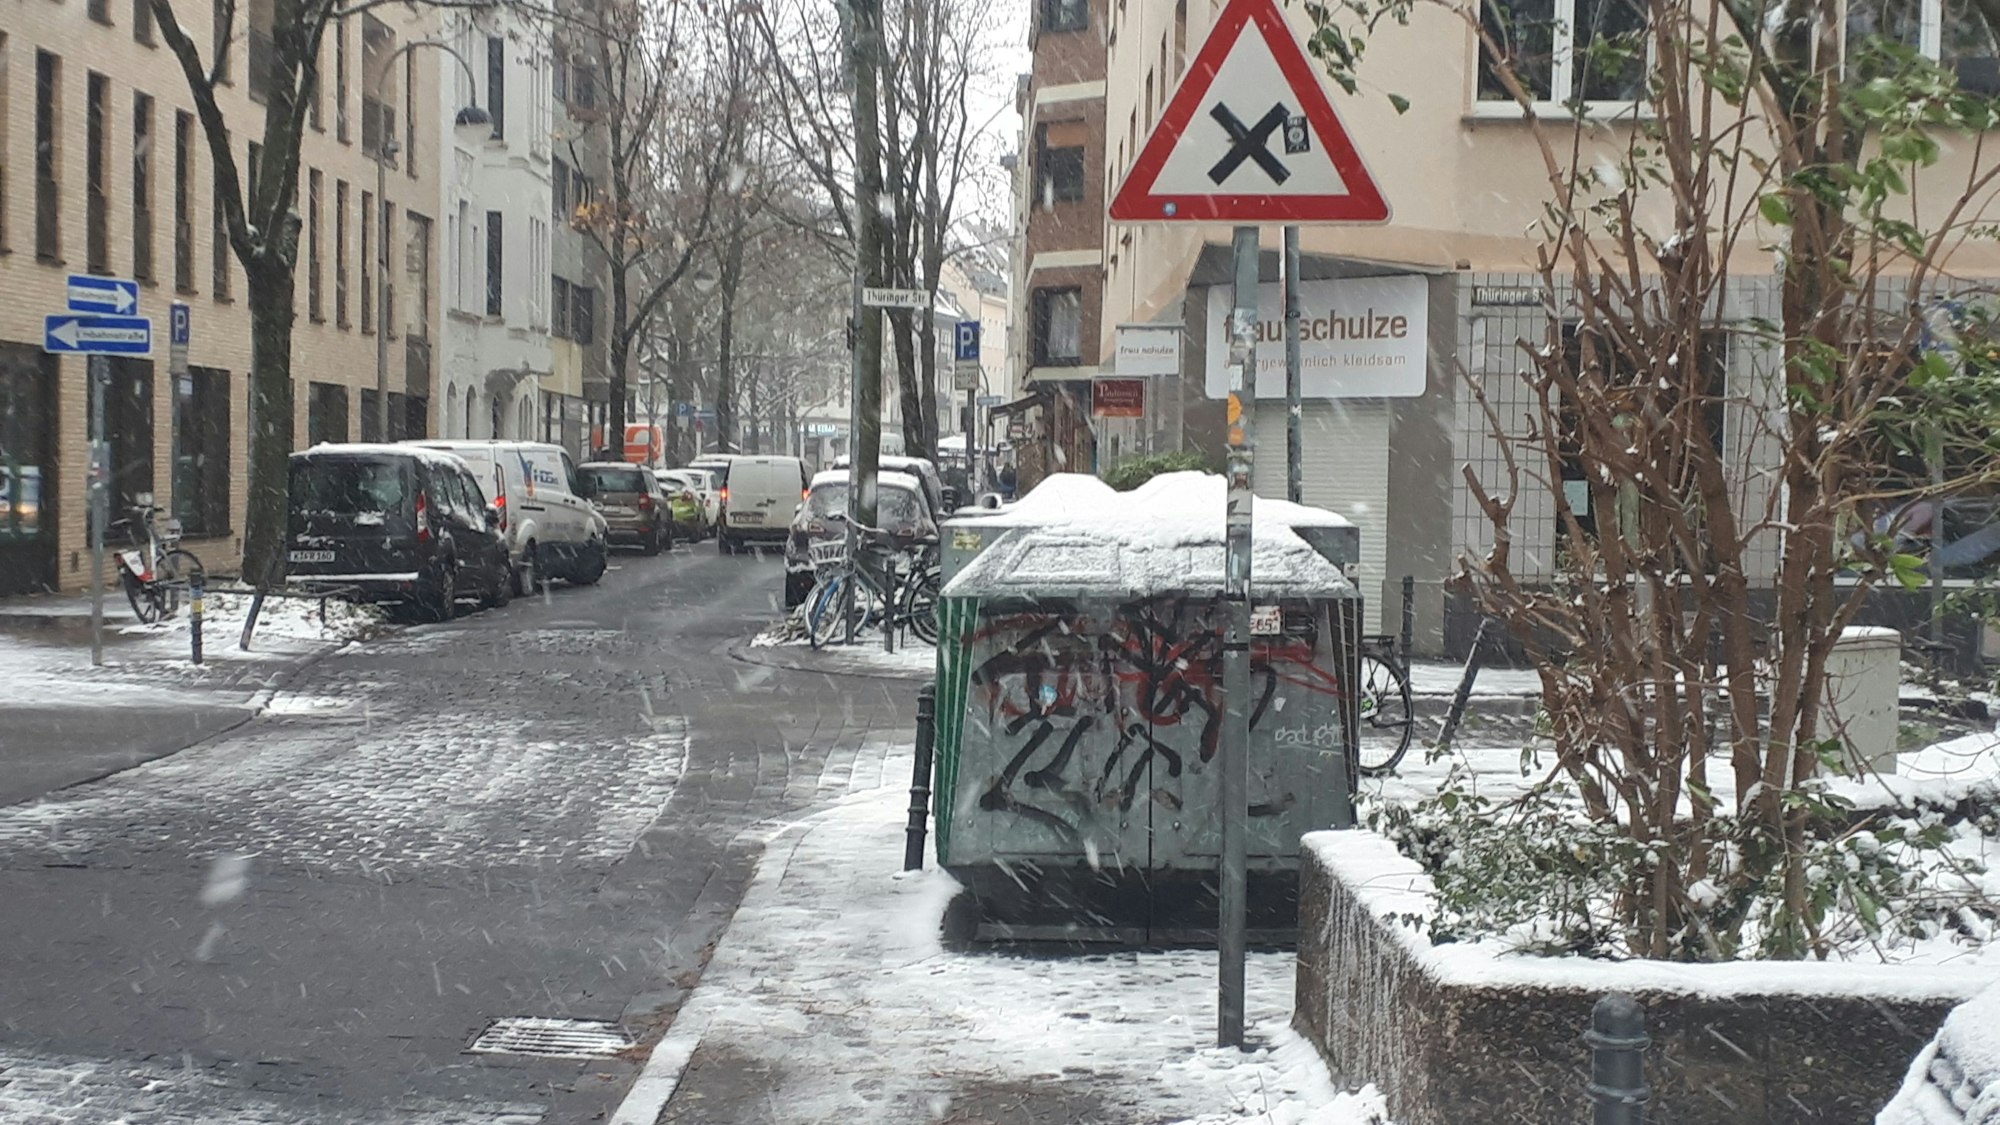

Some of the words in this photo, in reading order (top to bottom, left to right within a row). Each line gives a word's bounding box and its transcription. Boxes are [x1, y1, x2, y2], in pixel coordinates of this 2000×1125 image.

[867, 290, 908, 304] Thüringer
[1476, 288, 1527, 304] Thüringer
[1224, 313, 1282, 343] fau
[1299, 308, 1408, 341] schulze
[960, 326, 973, 357] P
[1343, 354, 1406, 367] kleidsam
